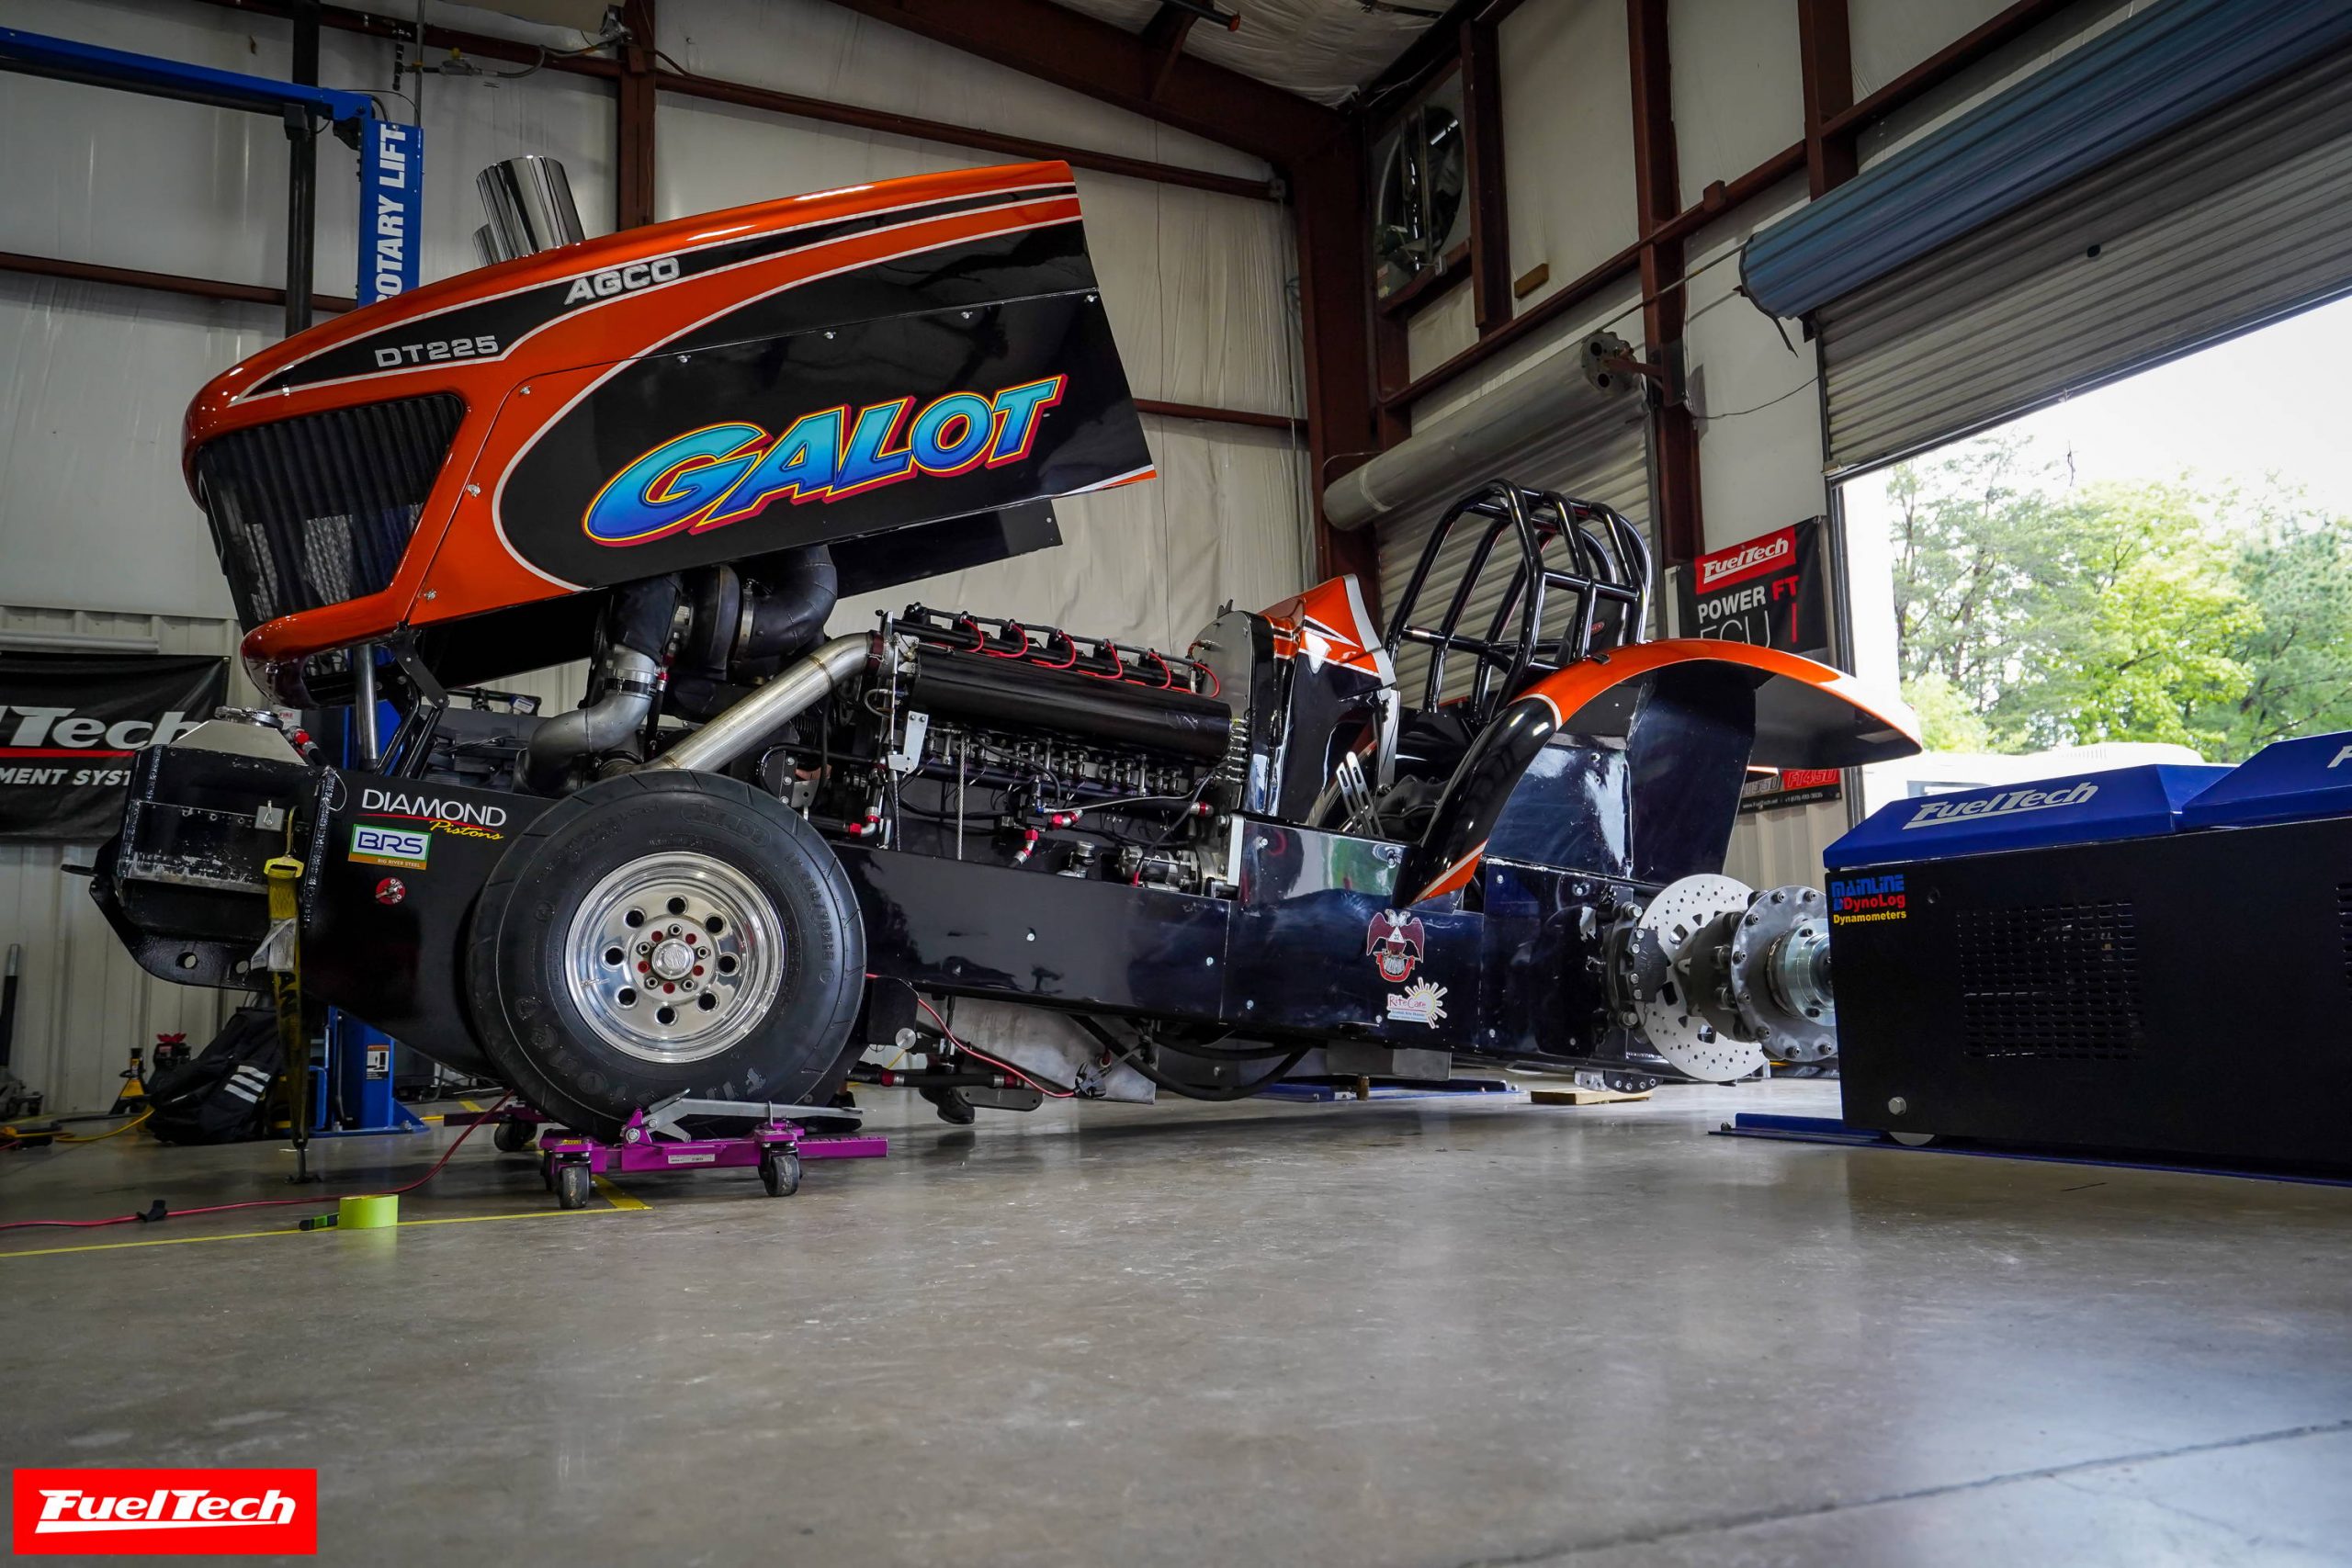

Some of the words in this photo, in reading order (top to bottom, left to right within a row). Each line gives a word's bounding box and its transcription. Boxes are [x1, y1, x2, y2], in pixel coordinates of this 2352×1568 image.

[379, 123, 406, 188] LIFT
[376, 194, 404, 302] OTARY
[564, 256, 681, 305] AGCO
[374, 335, 499, 367] DT225
[581, 374, 1068, 547] GALOT
[1702, 537, 1790, 584] FuelTech
[1698, 585, 1767, 624] POWER
[1771, 575, 1799, 601] FT
[1700, 610, 1771, 649] CU
[0, 705, 206, 750] Tech
[361, 788, 507, 827] DIAMOND
[1904, 782, 2099, 829] FuelTech
[357, 830, 424, 855] BRS
[429, 819, 504, 840] Pistons
[1833, 910, 1907, 926] Dynamometers
